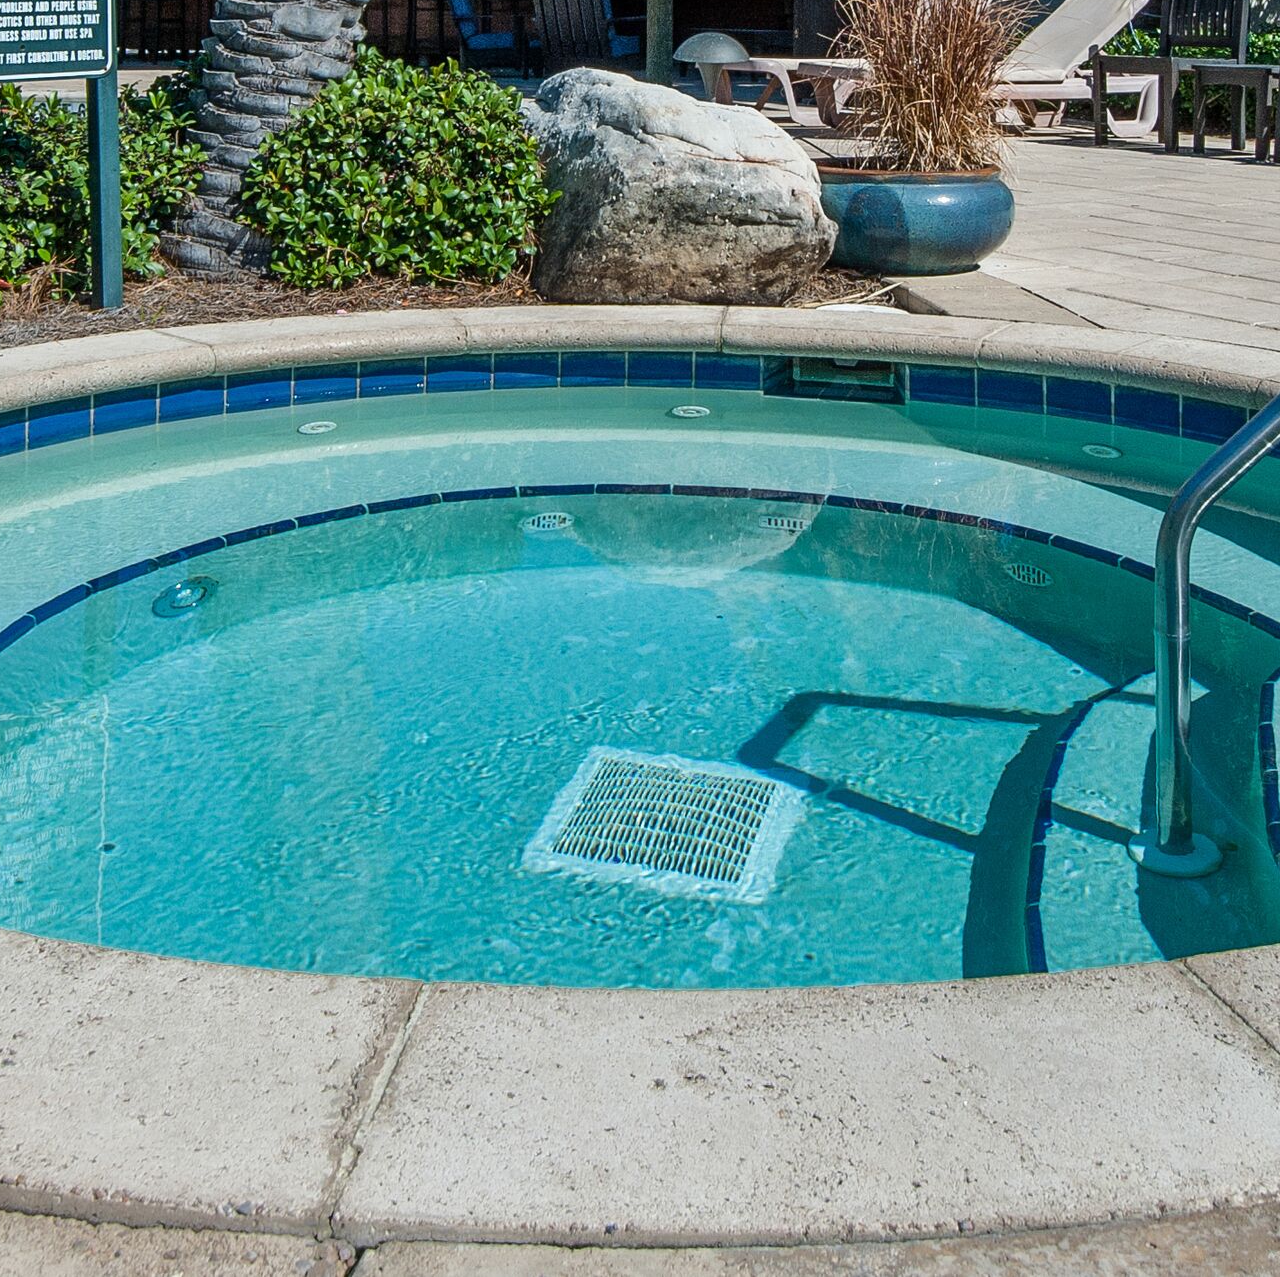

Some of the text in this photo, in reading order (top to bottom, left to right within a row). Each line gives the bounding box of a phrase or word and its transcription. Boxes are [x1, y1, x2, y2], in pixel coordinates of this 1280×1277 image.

[35, 1, 49, 12] AND
[51, 1, 75, 12] PEOPLE
[77, 0, 97, 11] USING
[24, 16, 34, 27] OR
[36, 15, 57, 26] OTHER
[59, 14, 81, 26] DRUGS
[84, 14, 100, 25] THAT
[21, 30, 47, 41] SHOULD
[49, 29, 62, 40] NOT
[64, 28, 77, 39] USE
[80, 28, 93, 39] SPA
[6, 52, 26, 64] FIRST
[28, 51, 68, 63] CONSULTING
[71, 50, 75, 61] A
[78, 49, 105, 61] DOCTOR.
